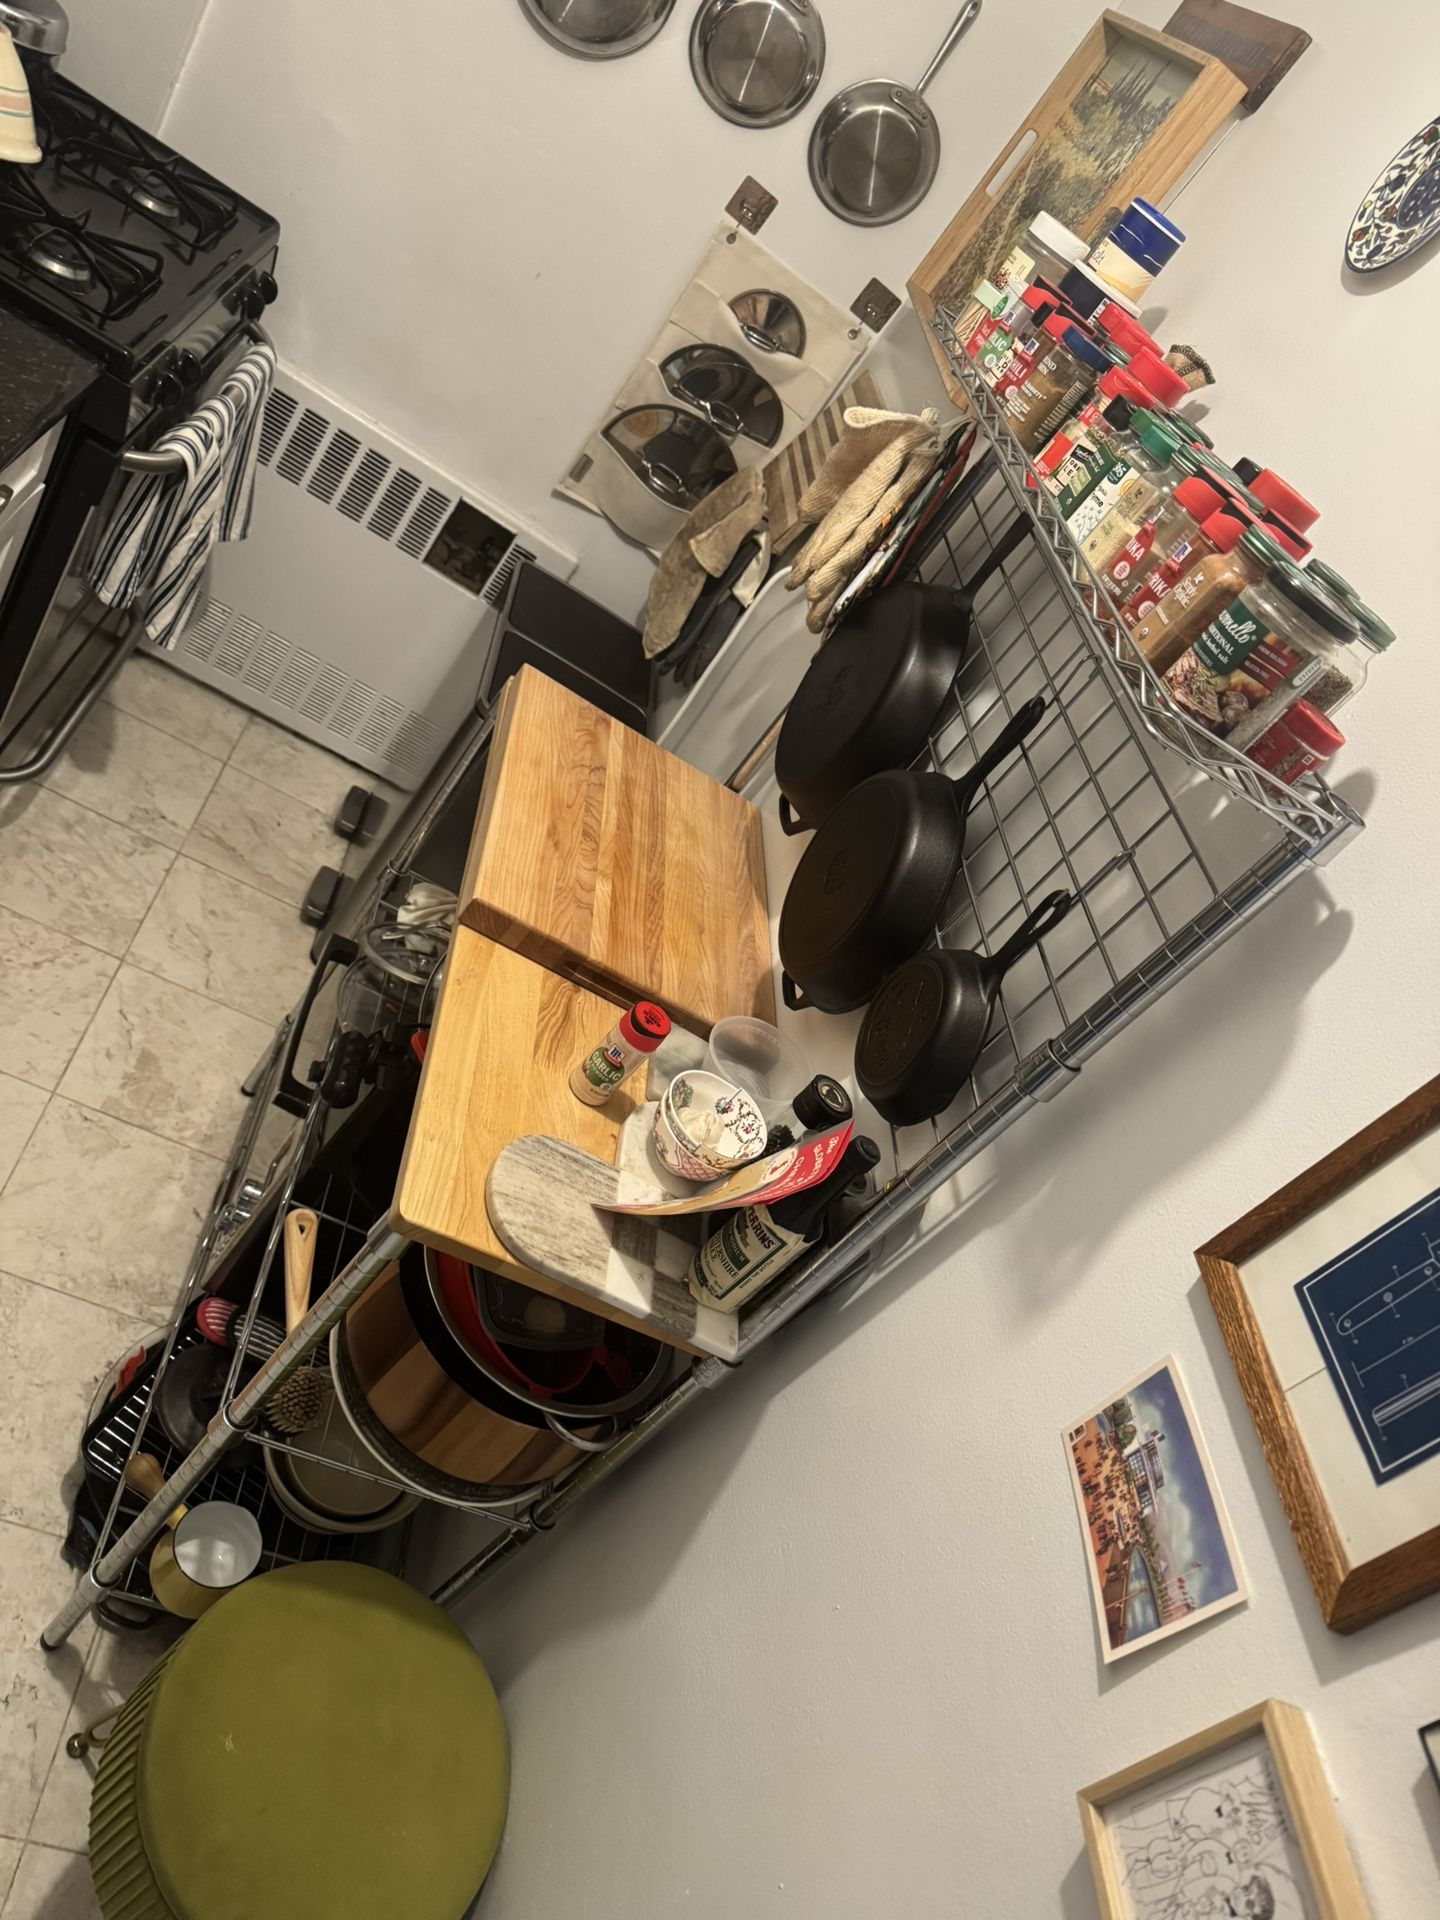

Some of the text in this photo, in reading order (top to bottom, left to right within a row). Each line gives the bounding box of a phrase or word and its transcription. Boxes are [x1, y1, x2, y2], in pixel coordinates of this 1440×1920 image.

[1009, 359, 1027, 378] HILI
[1091, 492, 1103, 507] yme
[592, 1051, 620, 1081] GARLIC
